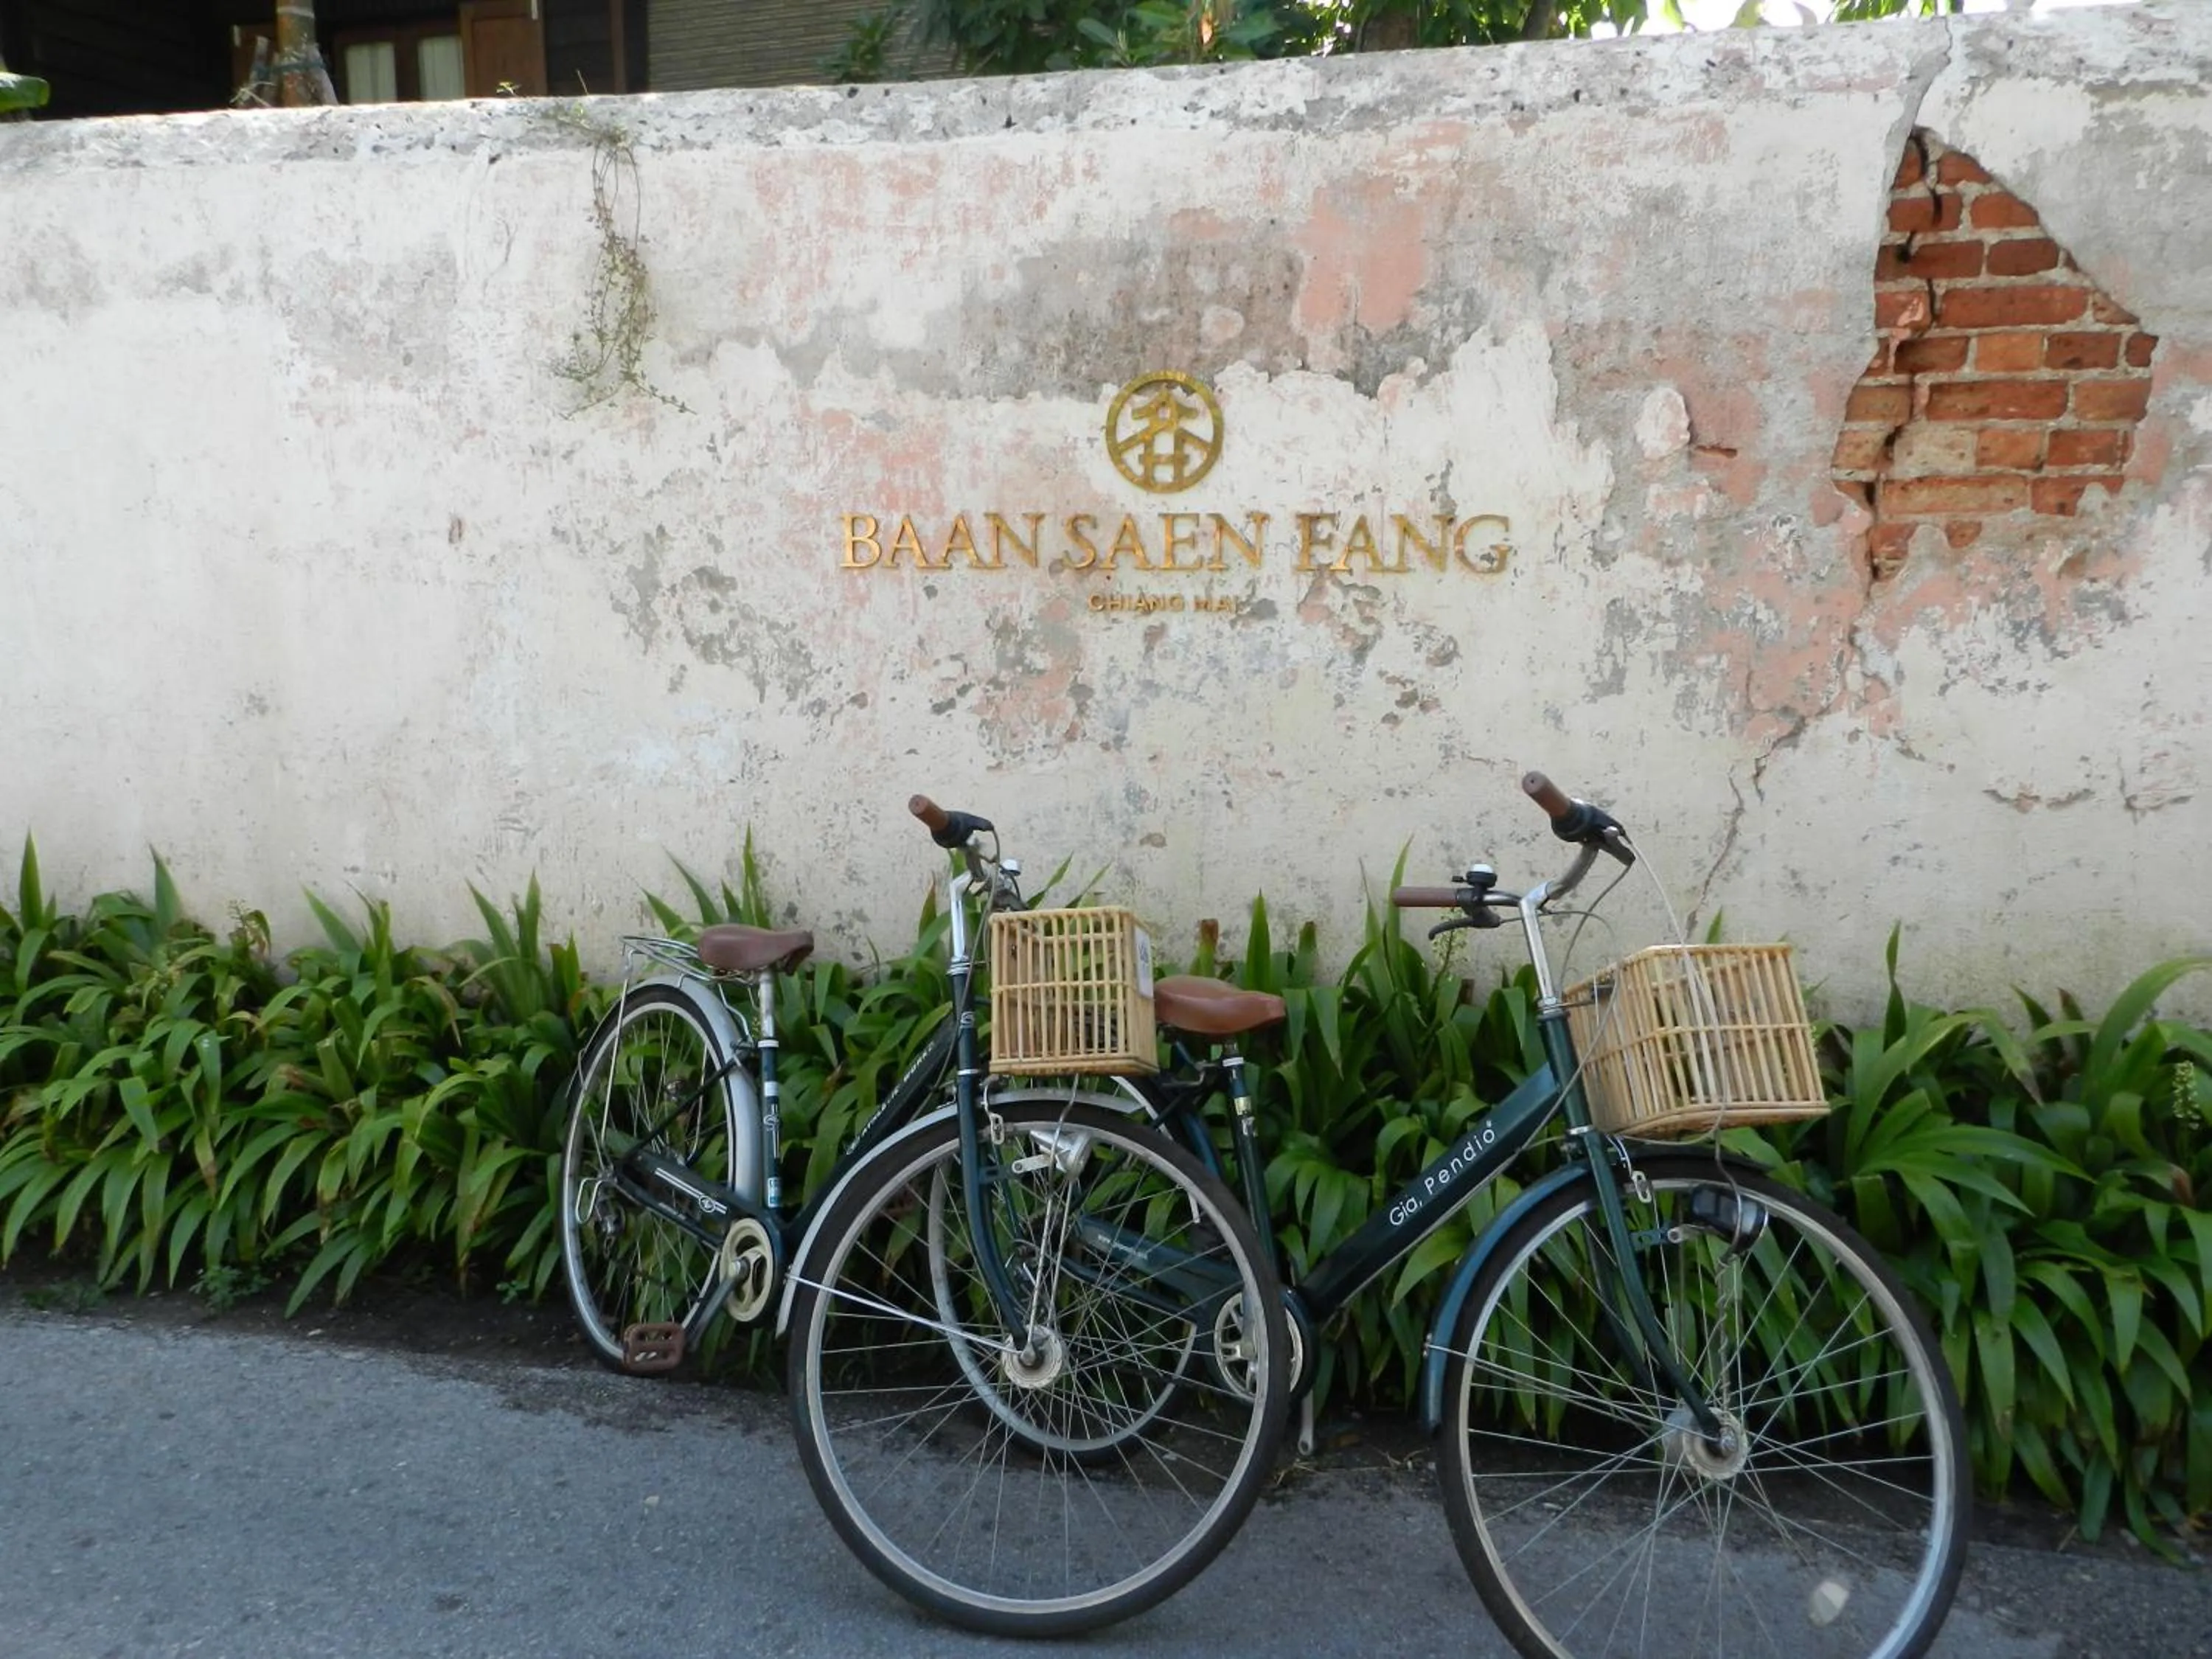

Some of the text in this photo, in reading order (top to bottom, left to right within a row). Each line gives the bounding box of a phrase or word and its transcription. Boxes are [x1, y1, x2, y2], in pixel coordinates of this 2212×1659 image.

[840, 511, 1512, 574] BAAN SAEN FANG
[1088, 592, 1238, 613] CHIANG MAI
